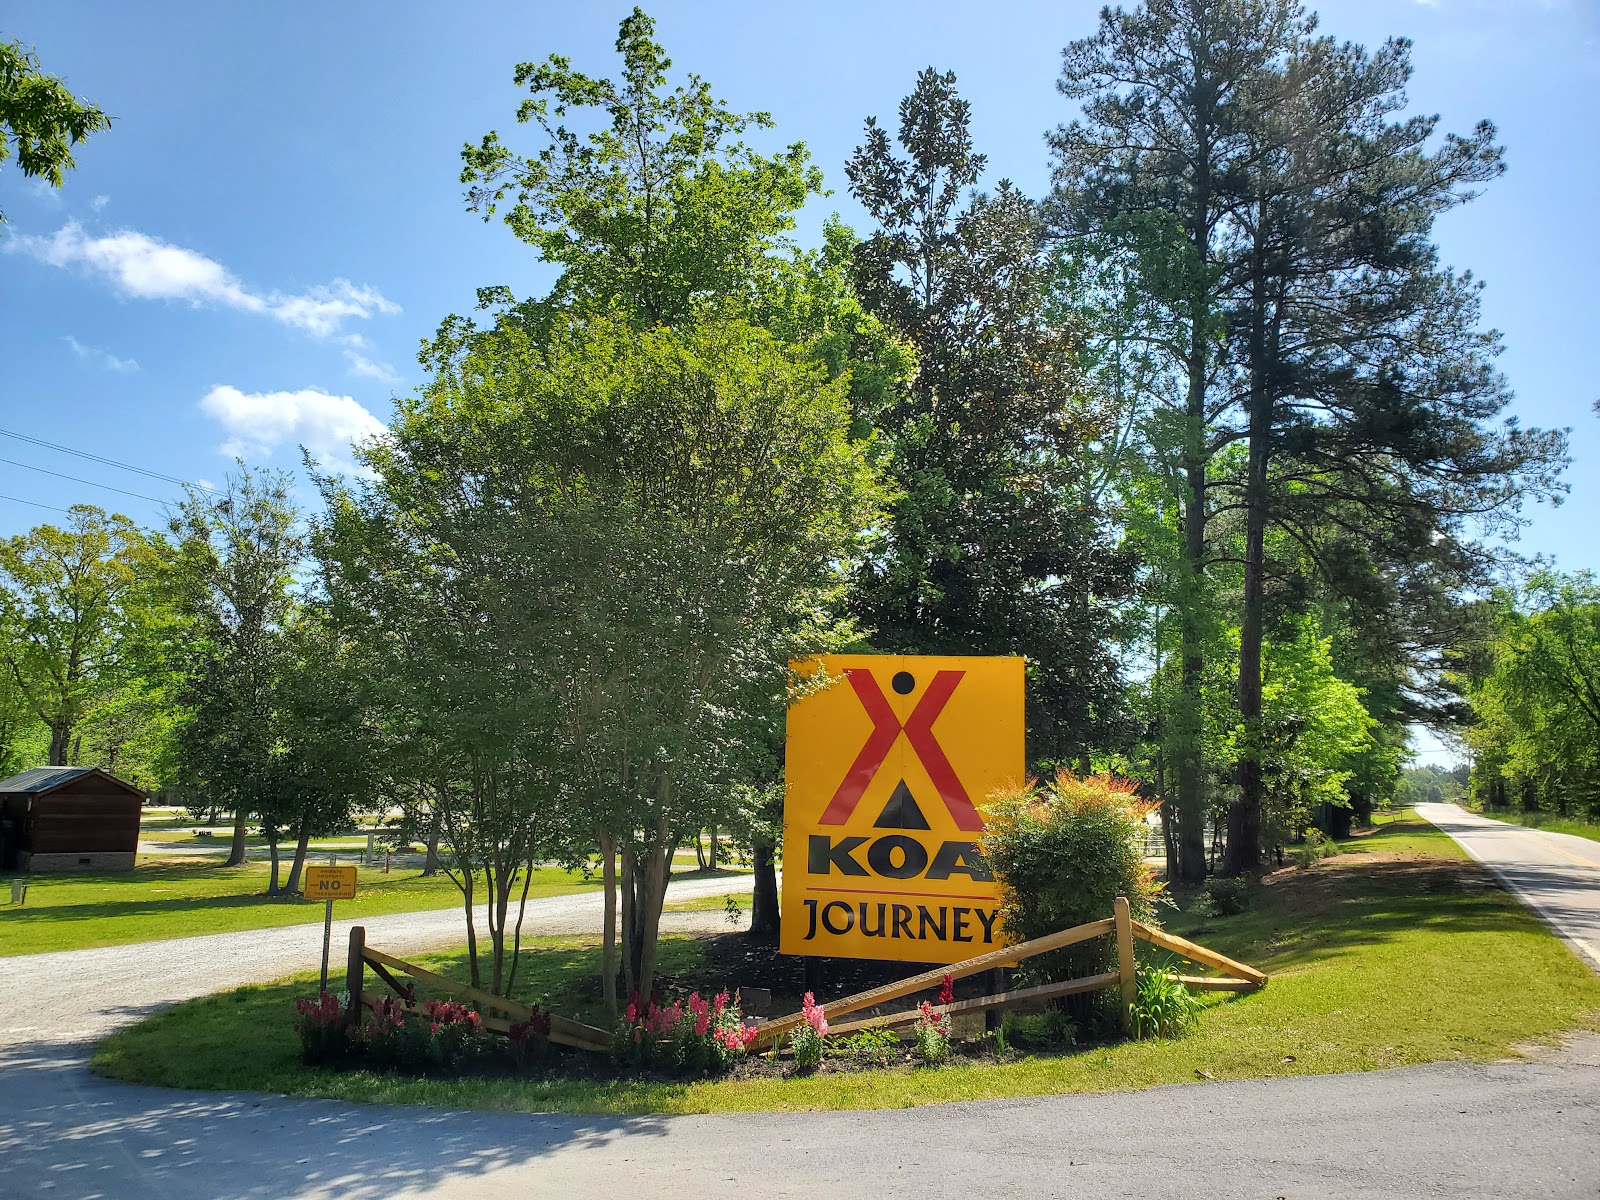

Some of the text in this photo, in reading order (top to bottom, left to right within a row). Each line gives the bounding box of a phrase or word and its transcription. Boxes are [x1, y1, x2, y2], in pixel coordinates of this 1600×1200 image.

[808, 834, 996, 882] KOA
[320, 880, 341, 890] NO
[803, 899, 1001, 944] JOURNEY
